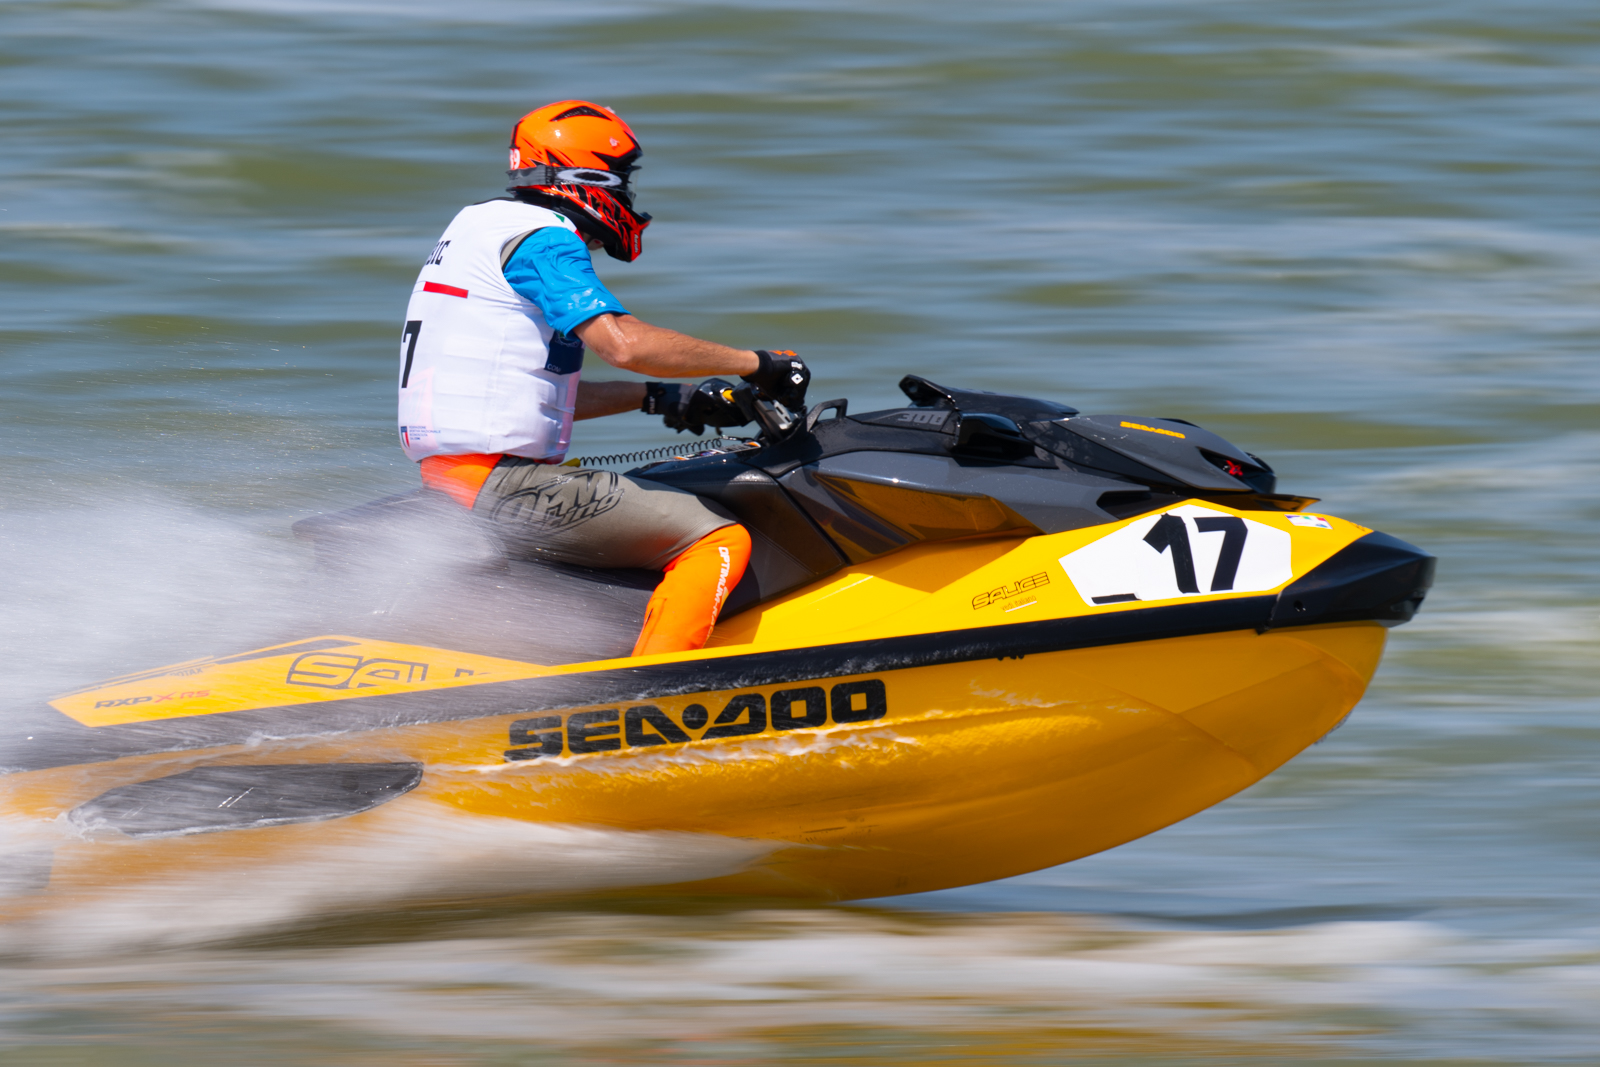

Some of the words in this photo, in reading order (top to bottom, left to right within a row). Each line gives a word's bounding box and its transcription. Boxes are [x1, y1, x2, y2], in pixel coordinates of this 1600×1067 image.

[897, 411, 949, 425] 300
[1143, 513, 1248, 594] 17
[972, 571, 1050, 610] SALICE
